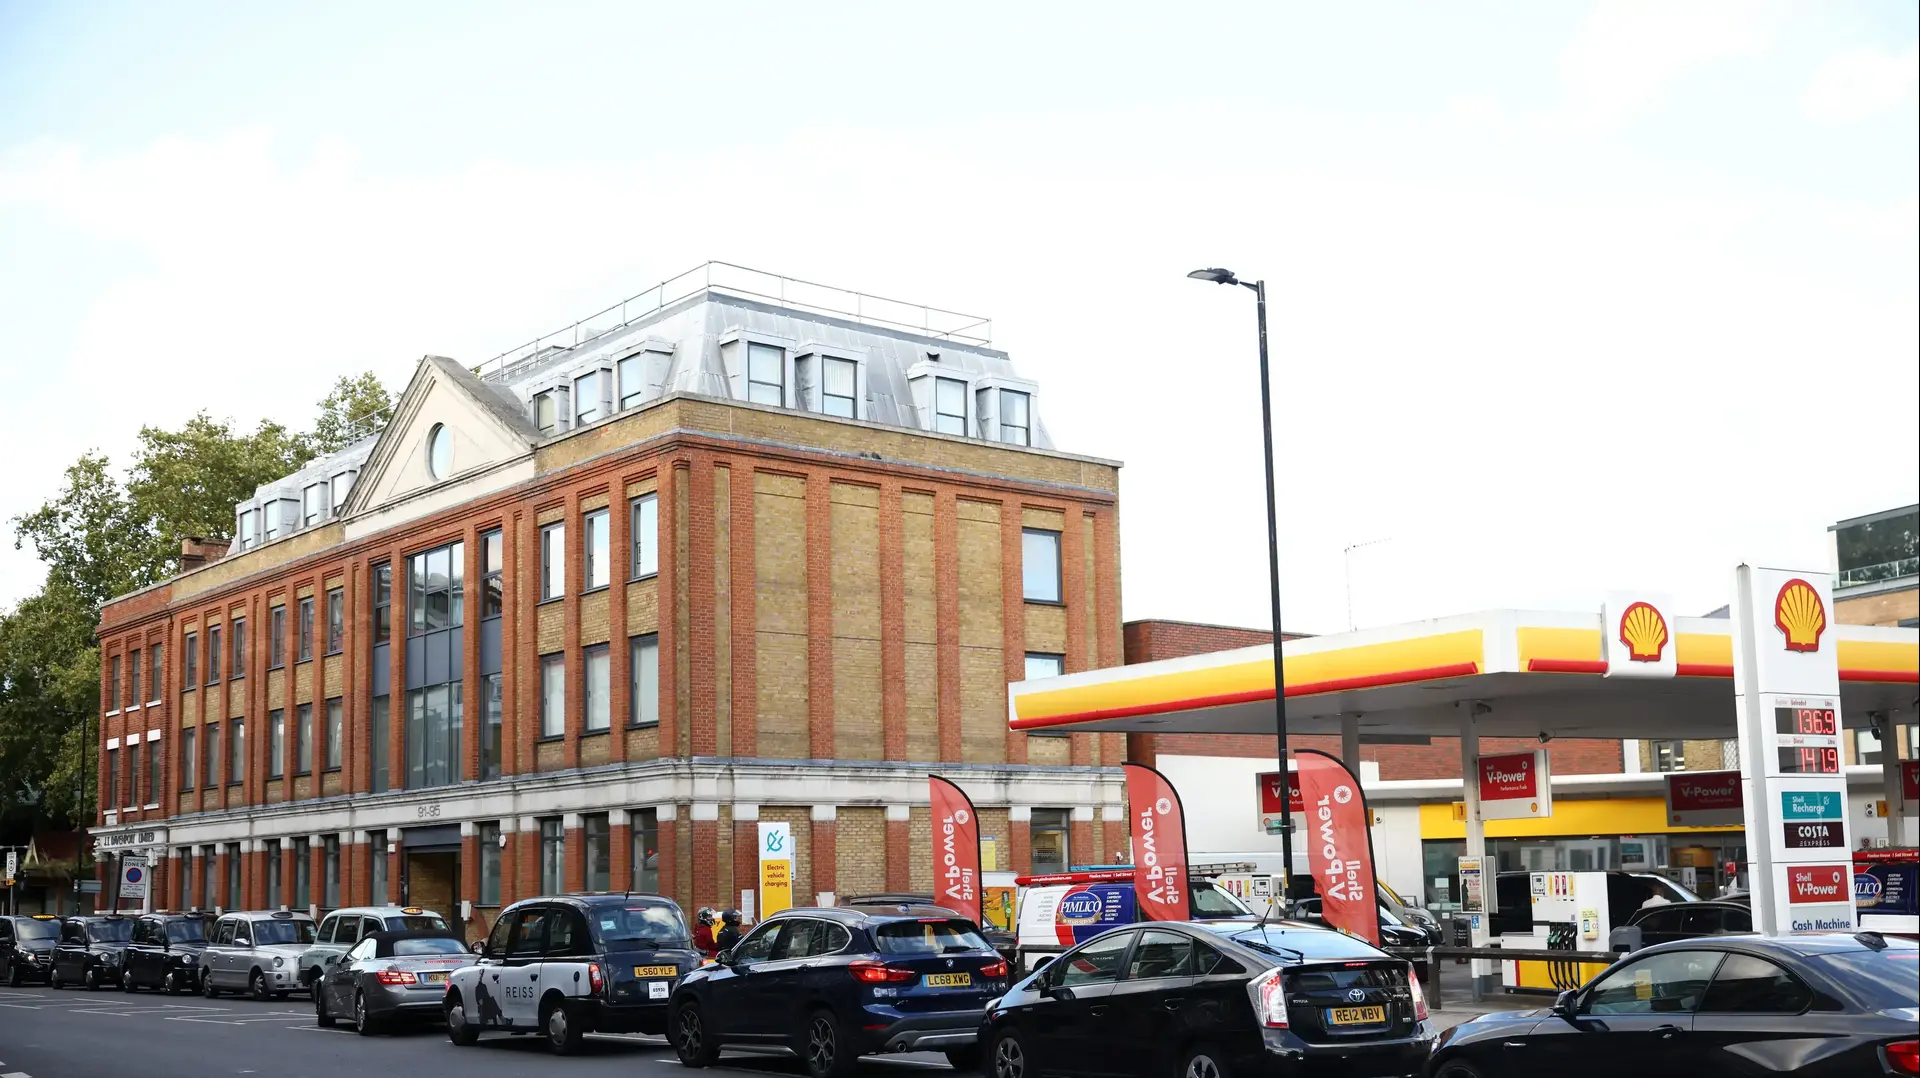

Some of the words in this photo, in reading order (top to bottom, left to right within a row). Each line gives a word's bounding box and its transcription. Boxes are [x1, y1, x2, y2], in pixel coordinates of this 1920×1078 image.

[1797, 709, 1835, 734] 136.9
[1800, 748, 1838, 773] 141.9
[1486, 770, 1526, 784] V-Power
[1681, 787, 1733, 797] V-Power
[417, 804, 441, 818] 91-95
[1459, 805, 1464, 816] 1
[1792, 803, 1825, 815] Recharge
[1798, 825, 1829, 839] COSTA
[1796, 872, 1812, 882] Shell
[765, 880, 788, 888] charging
[1796, 883, 1838, 896] V-Power
[1061, 900, 1102, 913] PIMLICO
[1792, 919, 1813, 931] Cash
[1815, 918, 1851, 930] Machine
[638, 967, 658, 976] LS60
[659, 967, 673, 975] YLF
[928, 975, 952, 985] LC68
[953, 974, 970, 984] XWG
[505, 986, 534, 998] REISS
[1335, 1008, 1360, 1022] RE12
[1361, 1007, 1381, 1020] WBV
